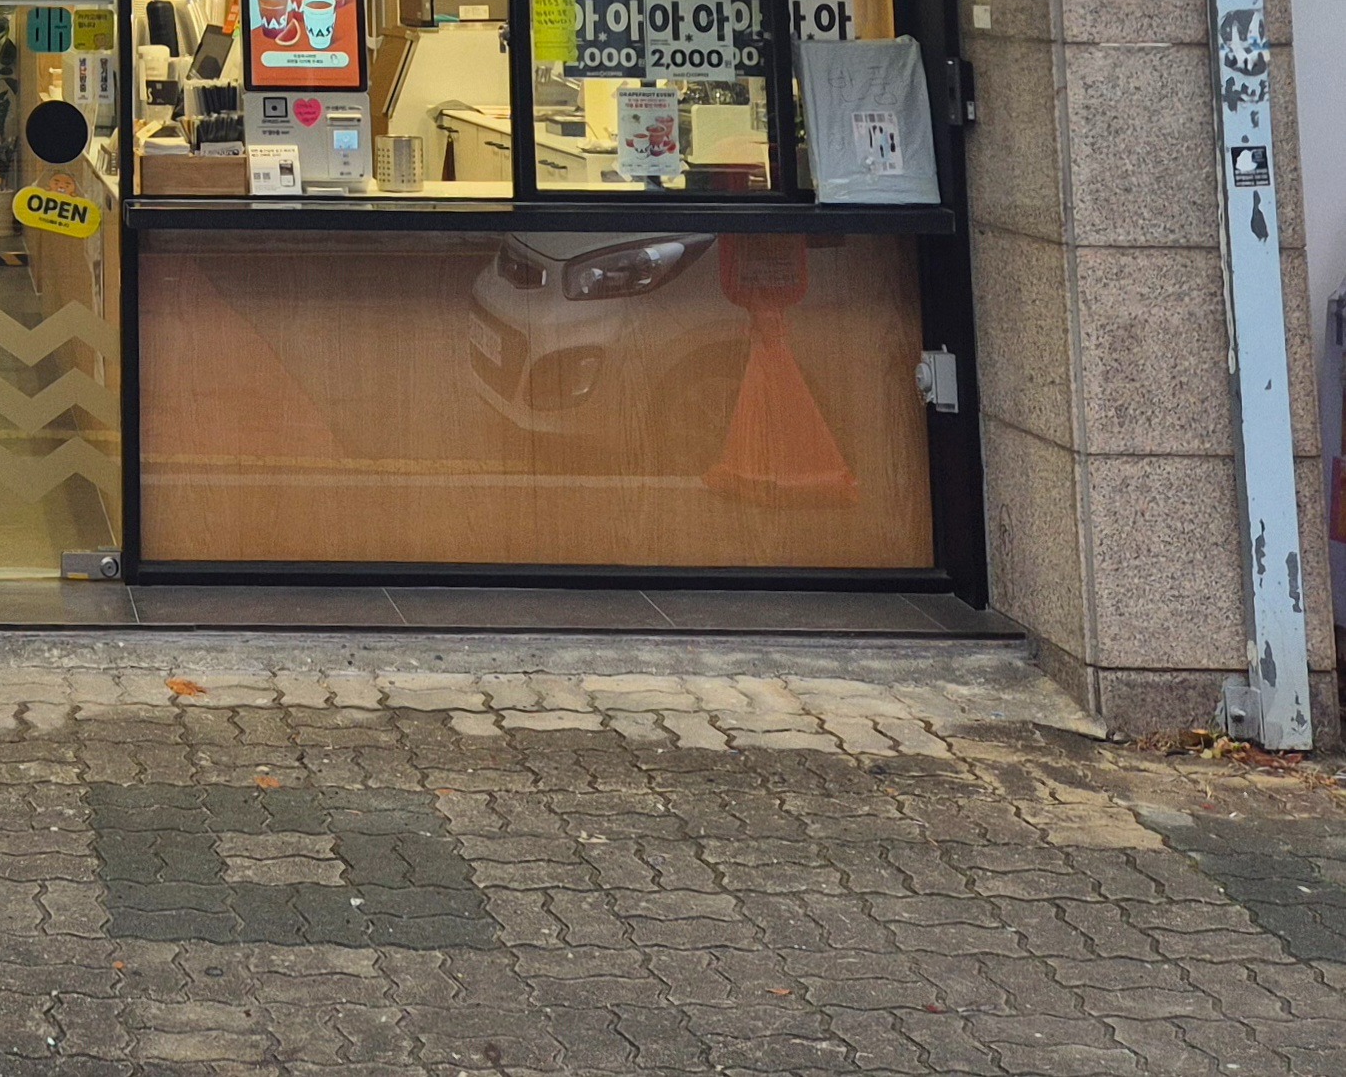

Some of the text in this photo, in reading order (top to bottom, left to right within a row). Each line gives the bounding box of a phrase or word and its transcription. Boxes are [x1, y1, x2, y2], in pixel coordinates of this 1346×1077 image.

[565, 47, 637, 69] ,000
[651, 49, 724, 70] 2,000
[26, 194, 89, 224] OPEN
